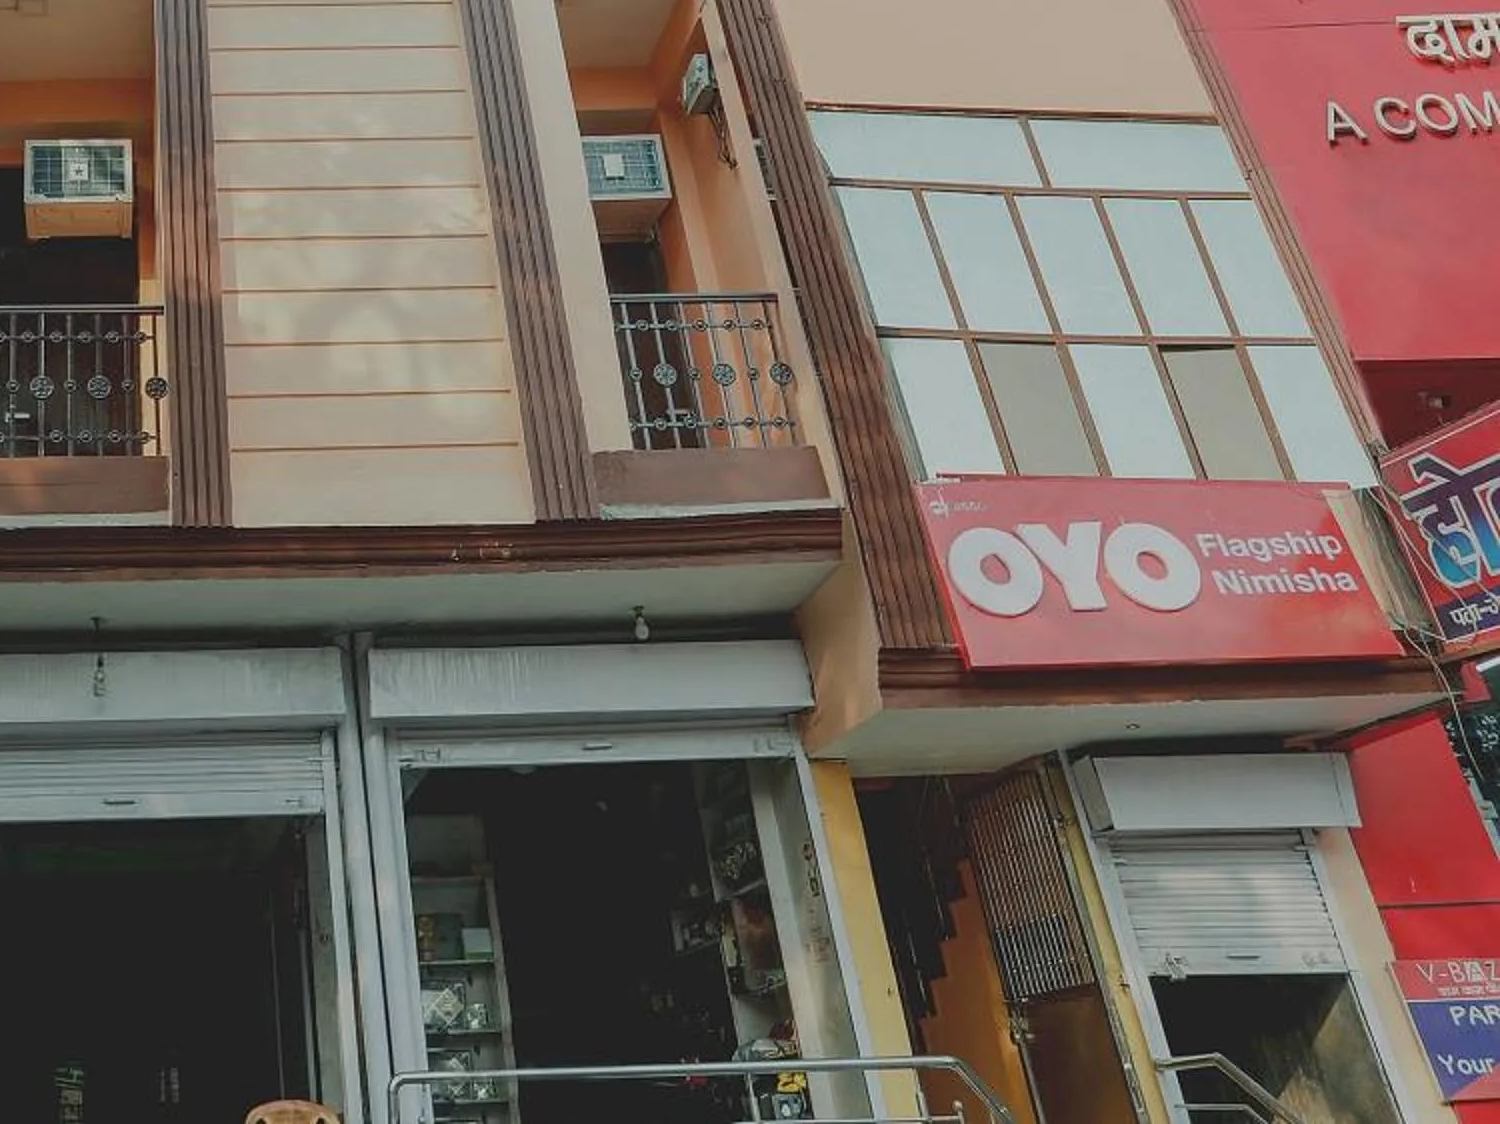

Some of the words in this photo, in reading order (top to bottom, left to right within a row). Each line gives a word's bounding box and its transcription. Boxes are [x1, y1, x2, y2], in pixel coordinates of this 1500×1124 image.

[1327, 99, 1369, 146] A
[947, 521, 1201, 617] OYO
[1196, 531, 1343, 562] Flagship
[1212, 567, 1359, 594] Nimisha
[1437, 1054, 1495, 1075] Your
